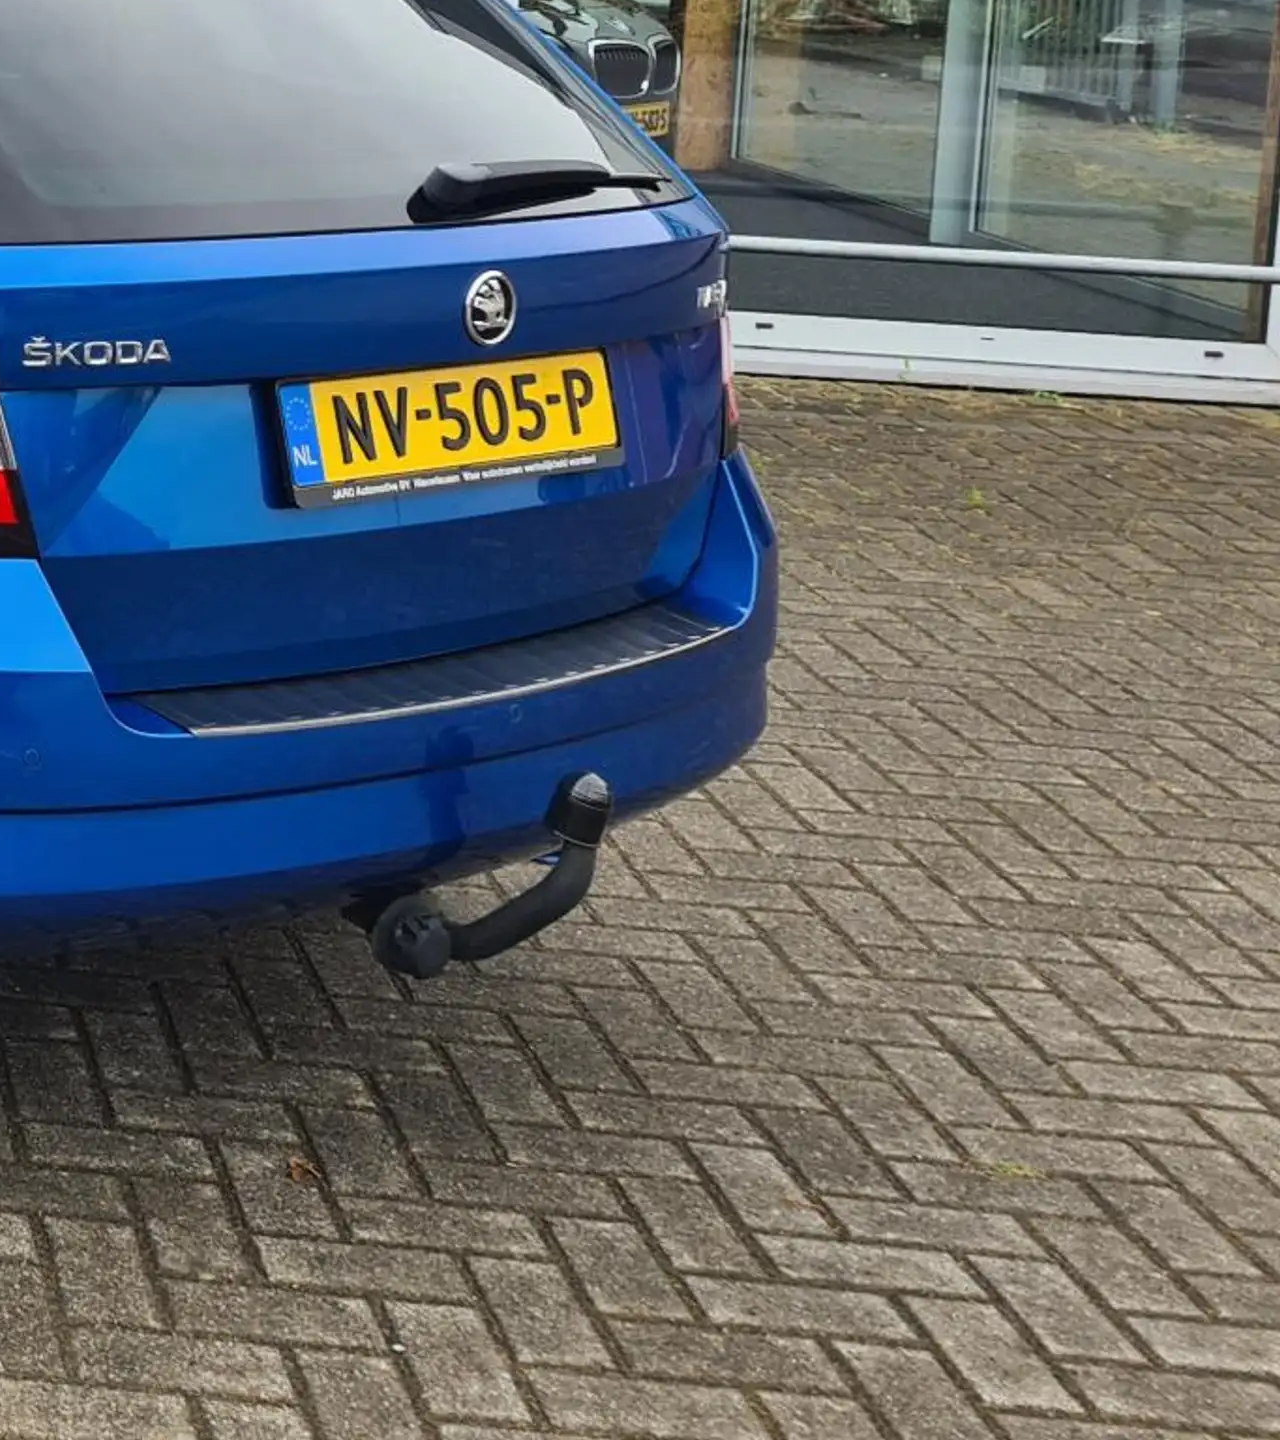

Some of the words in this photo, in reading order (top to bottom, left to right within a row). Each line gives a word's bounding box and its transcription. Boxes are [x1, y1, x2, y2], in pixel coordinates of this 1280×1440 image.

[21, 335, 172, 368] ŠKODA
[331, 368, 593, 465] NV-505-P
[292, 445, 317, 467] NL
